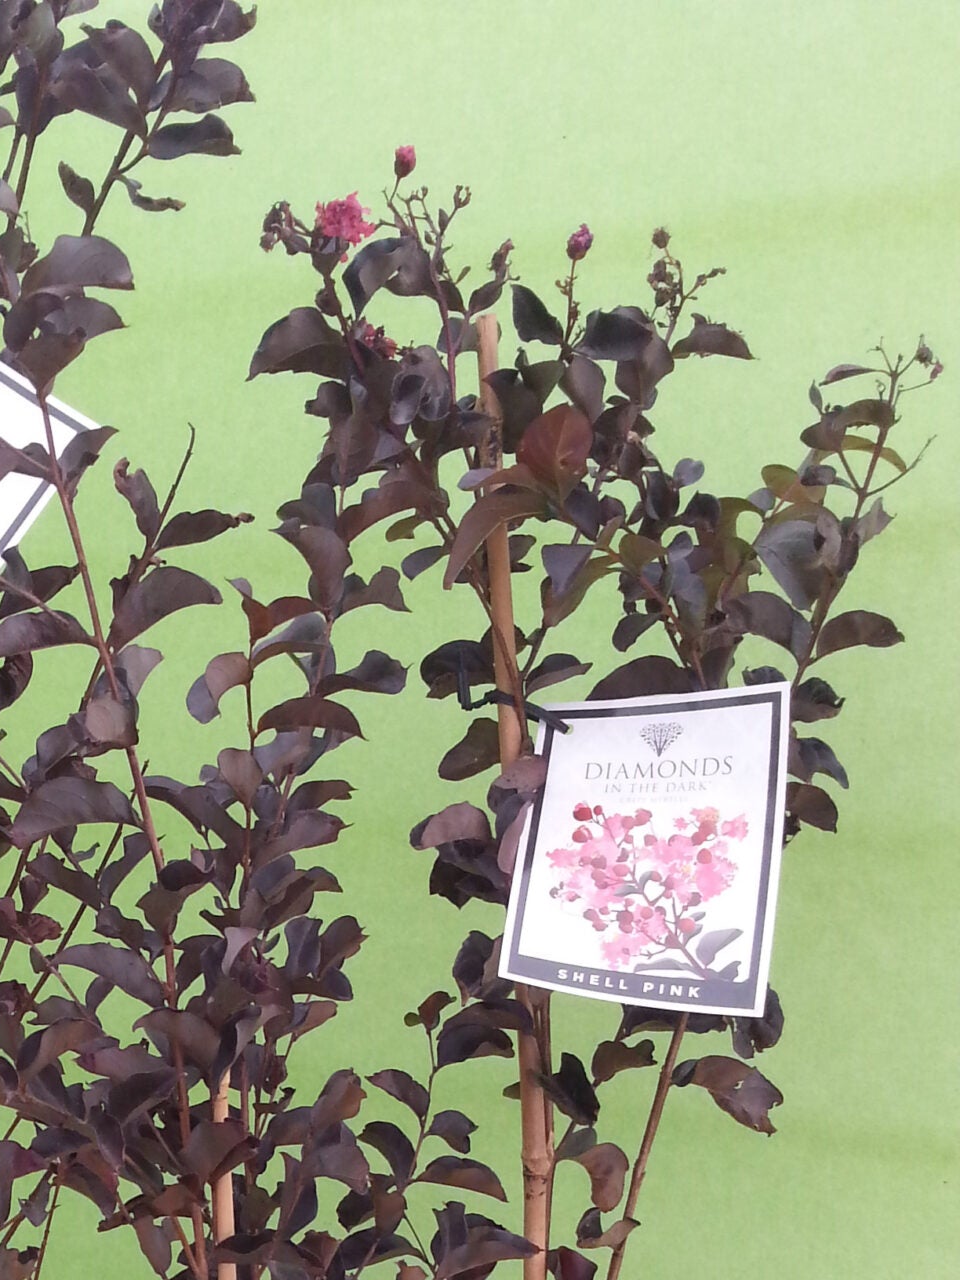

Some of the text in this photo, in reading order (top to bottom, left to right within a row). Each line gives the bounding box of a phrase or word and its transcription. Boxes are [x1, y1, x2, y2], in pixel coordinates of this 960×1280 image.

[585, 755, 734, 780] DIAMONDS
[604, 781, 708, 794] IN THE DARK
[557, 969, 701, 998] SHELL PINK
